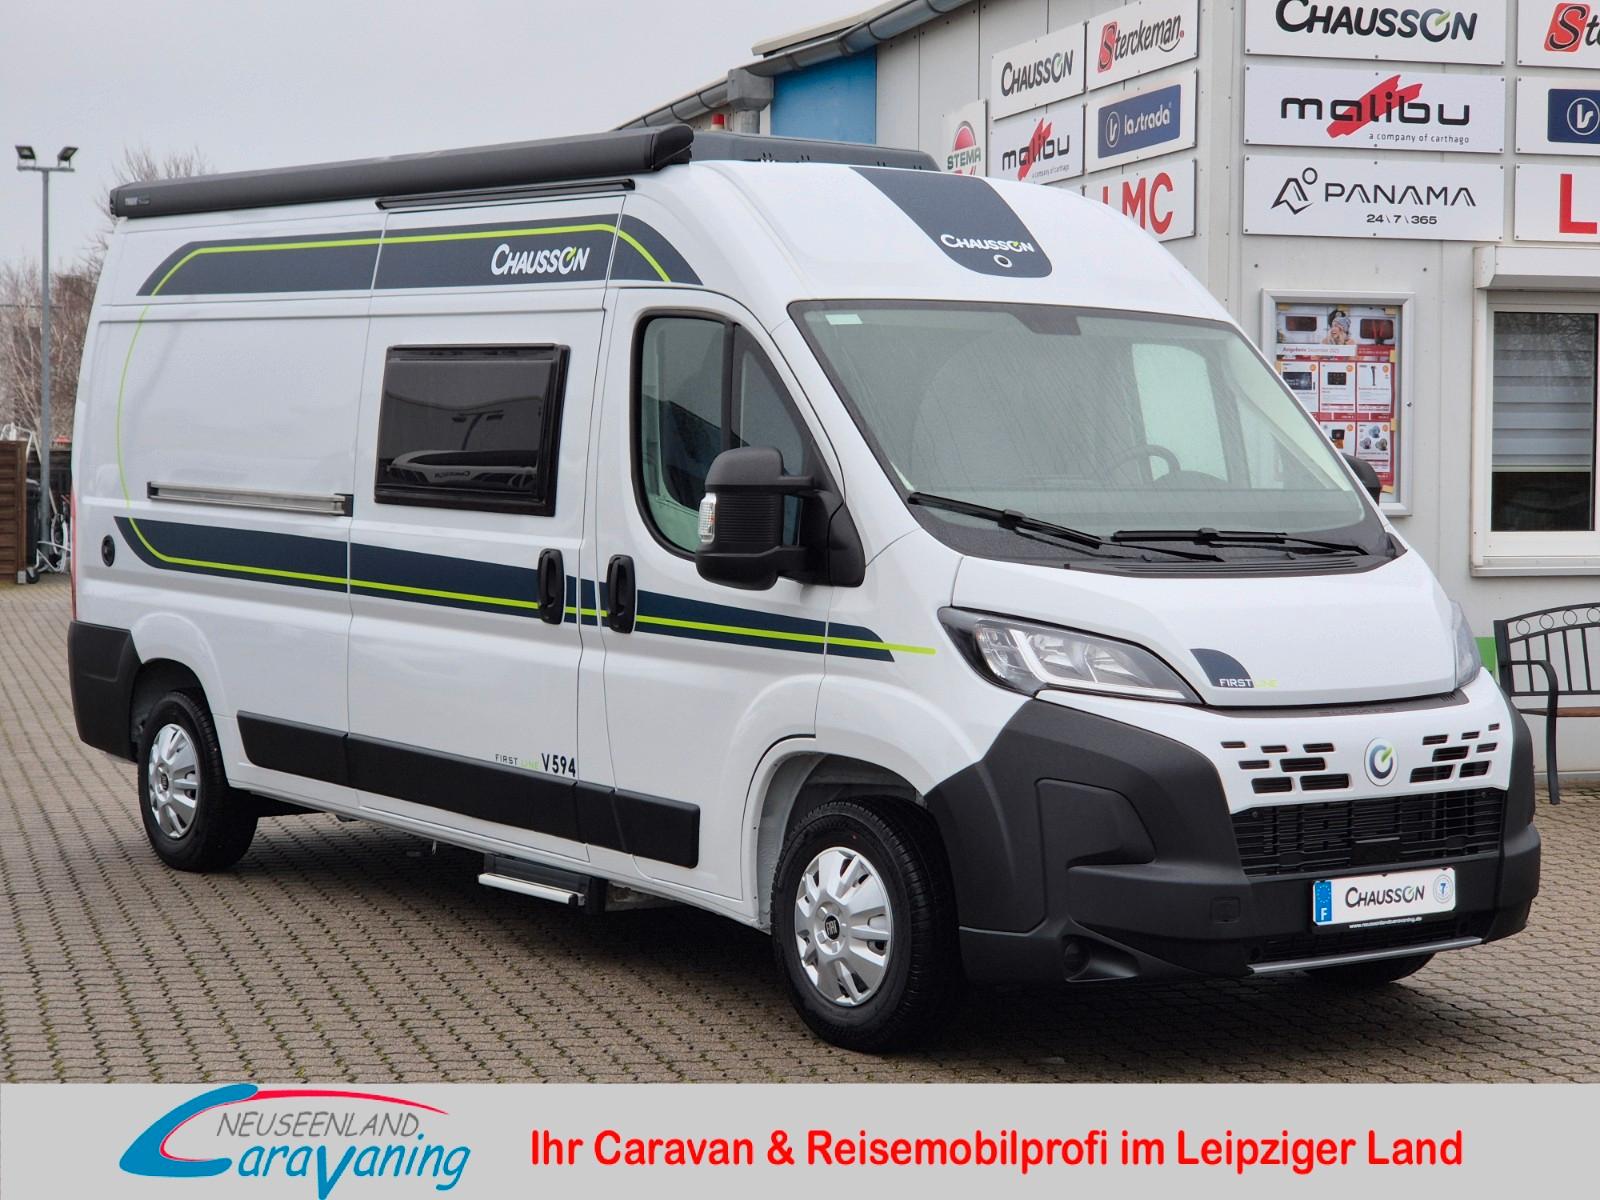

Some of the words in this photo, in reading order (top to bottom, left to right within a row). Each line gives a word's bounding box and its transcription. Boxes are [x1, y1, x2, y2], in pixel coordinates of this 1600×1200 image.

[1276, 0, 1477, 42] CHAUSSON
[1549, 5, 1600, 50] St
[1001, 49, 1073, 96] CHAUSSON
[1281, 92, 1470, 126] malibu
[1376, 133, 1416, 143] company
[1418, 133, 1428, 142] of
[1430, 135, 1470, 145] carthago
[947, 147, 981, 170] STEMA
[1002, 134, 1070, 171] malibu
[1324, 183, 1476, 207] PANAMA
[940, 234, 1035, 253] CHAUSSON
[491, 243, 590, 275] CHAUSSON
[1220, 678, 1252, 688] FIRST
[495, 753, 518, 766] FIRST
[541, 752, 576, 777] V594
[1345, 885, 1425, 908] CHAUSSON
[1321, 907, 1328, 921] F
